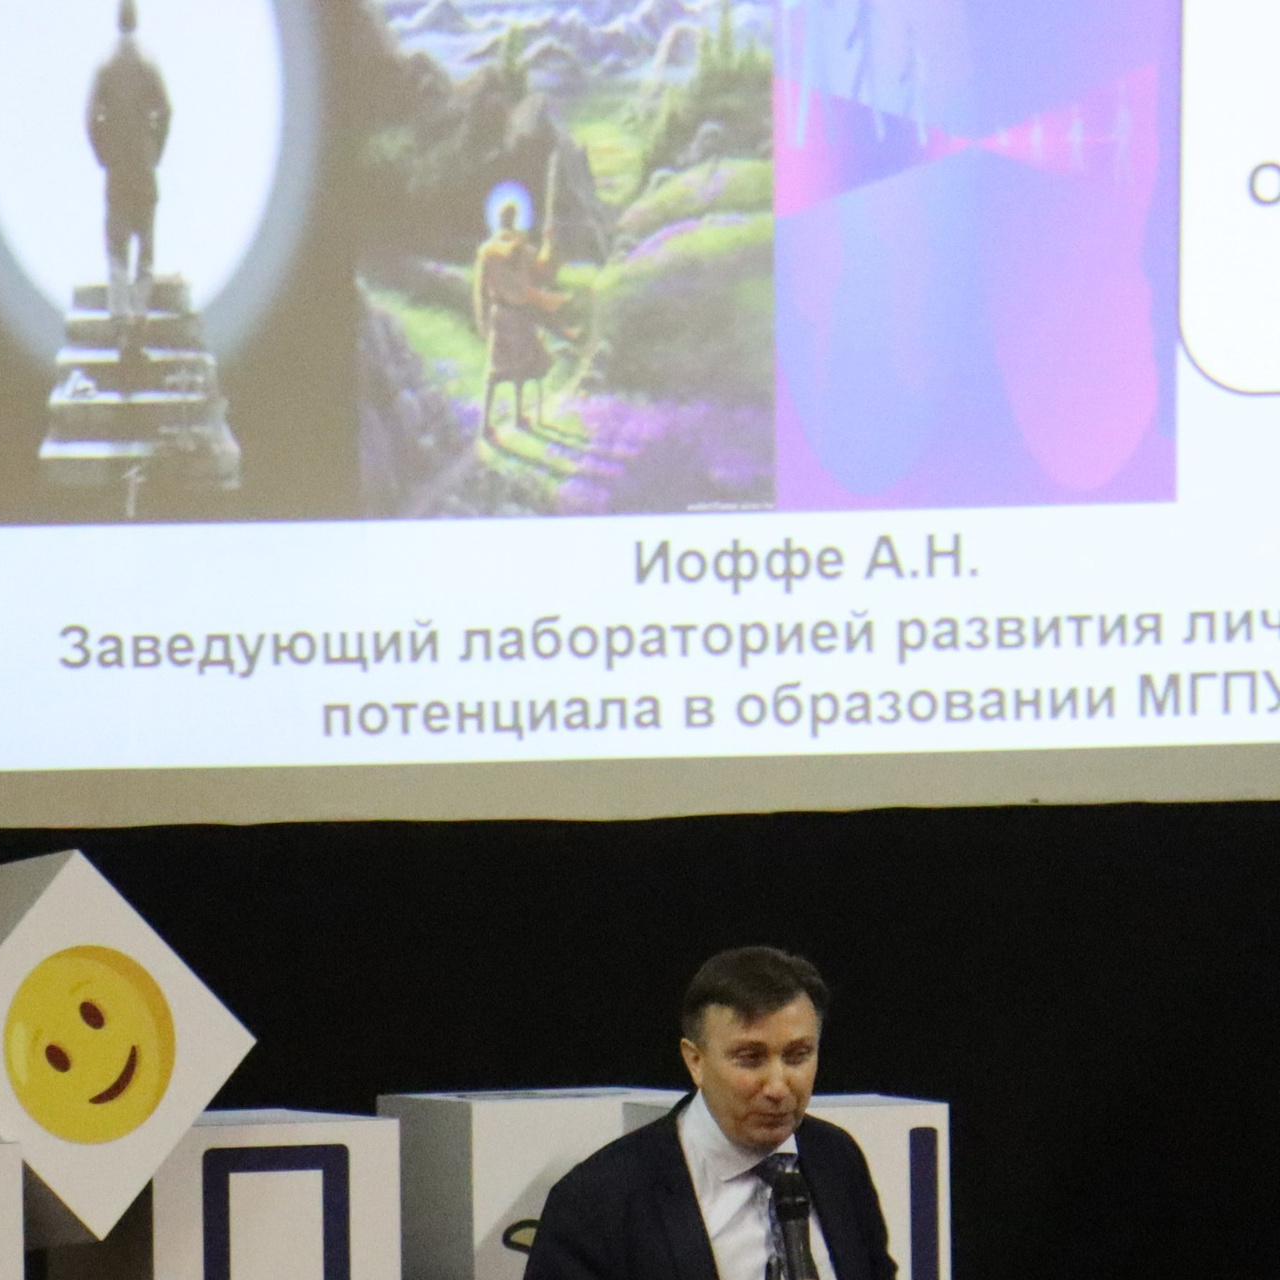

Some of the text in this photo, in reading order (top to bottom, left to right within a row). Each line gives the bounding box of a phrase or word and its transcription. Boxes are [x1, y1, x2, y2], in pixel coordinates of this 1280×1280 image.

[635, 533, 980, 596] Иоффе А.Н.
[59, 620, 440, 678] Заведующий
[459, 611, 875, 670] лабораторией
[898, 612, 1163, 665] развития
[323, 696, 662, 741] потенциала
[685, 695, 715, 729] в
[736, 681, 1116, 739] образовании
